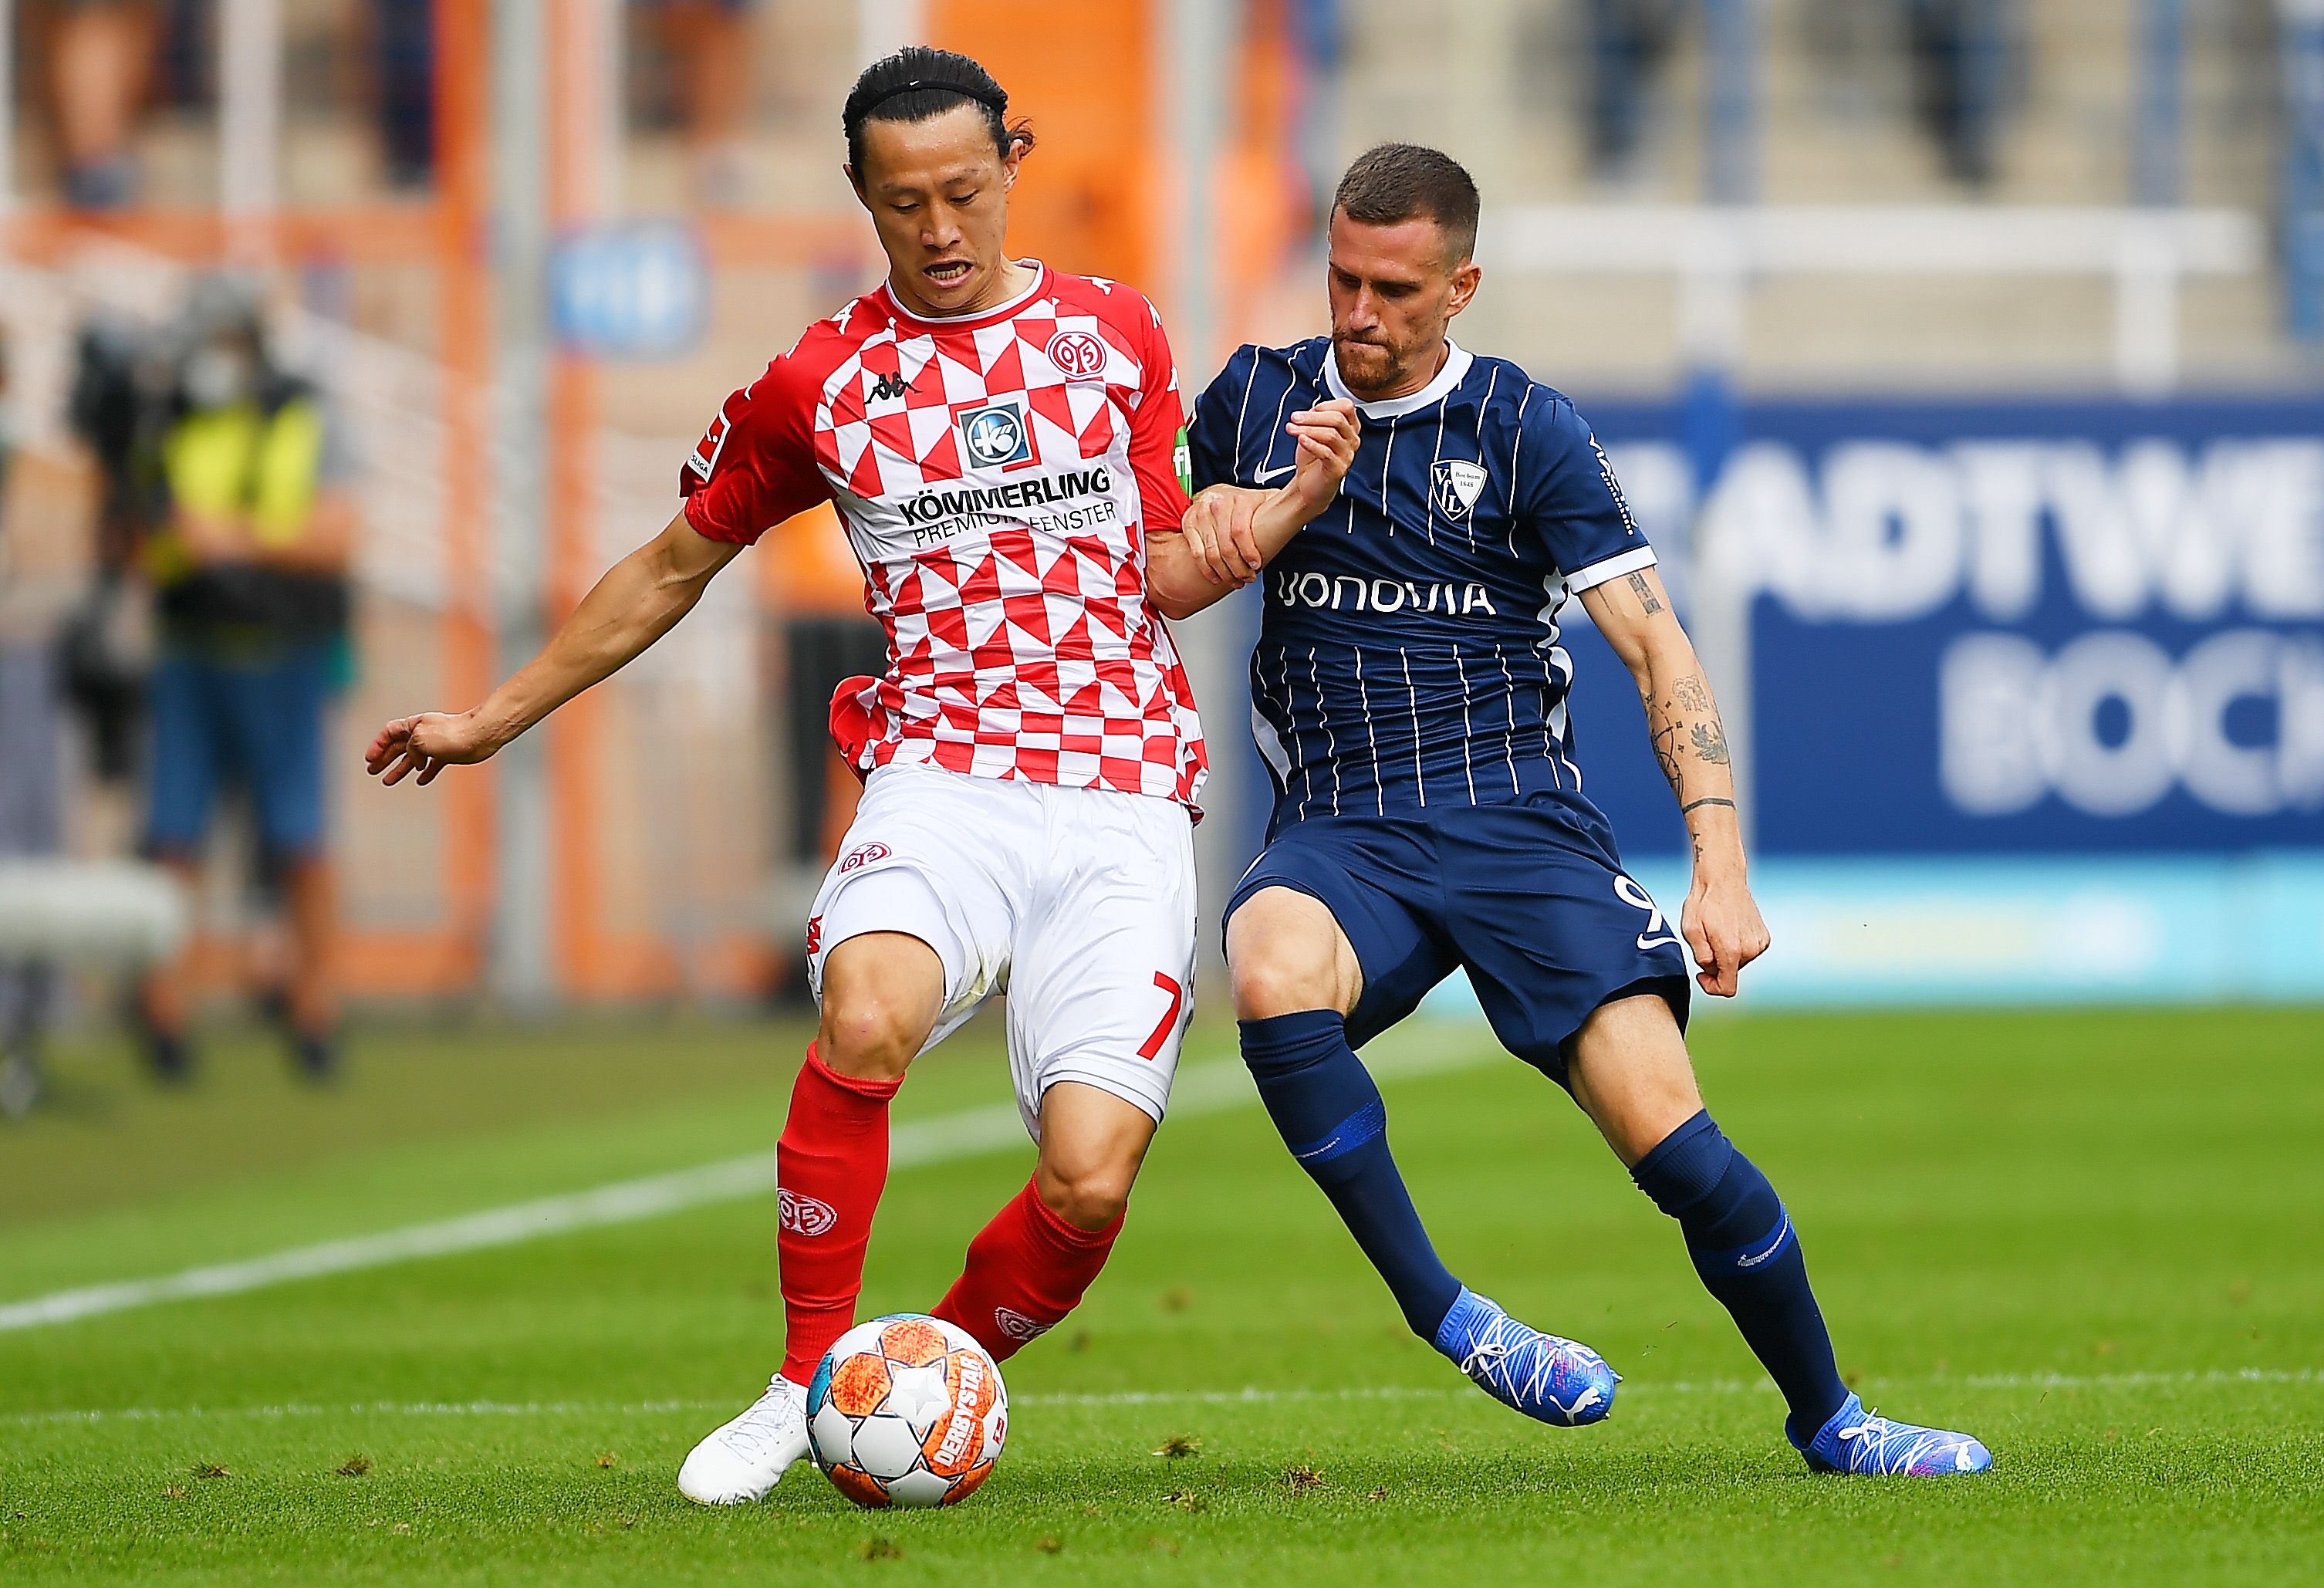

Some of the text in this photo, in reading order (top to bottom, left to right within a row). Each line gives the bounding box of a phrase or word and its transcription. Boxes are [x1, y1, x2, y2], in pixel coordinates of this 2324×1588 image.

[897, 468, 1111, 527] KÖMMERLING
[1613, 874, 1663, 933] 9
[1137, 970, 1183, 1062] 7
[933, 1355, 979, 1468] DERBYSTAR
